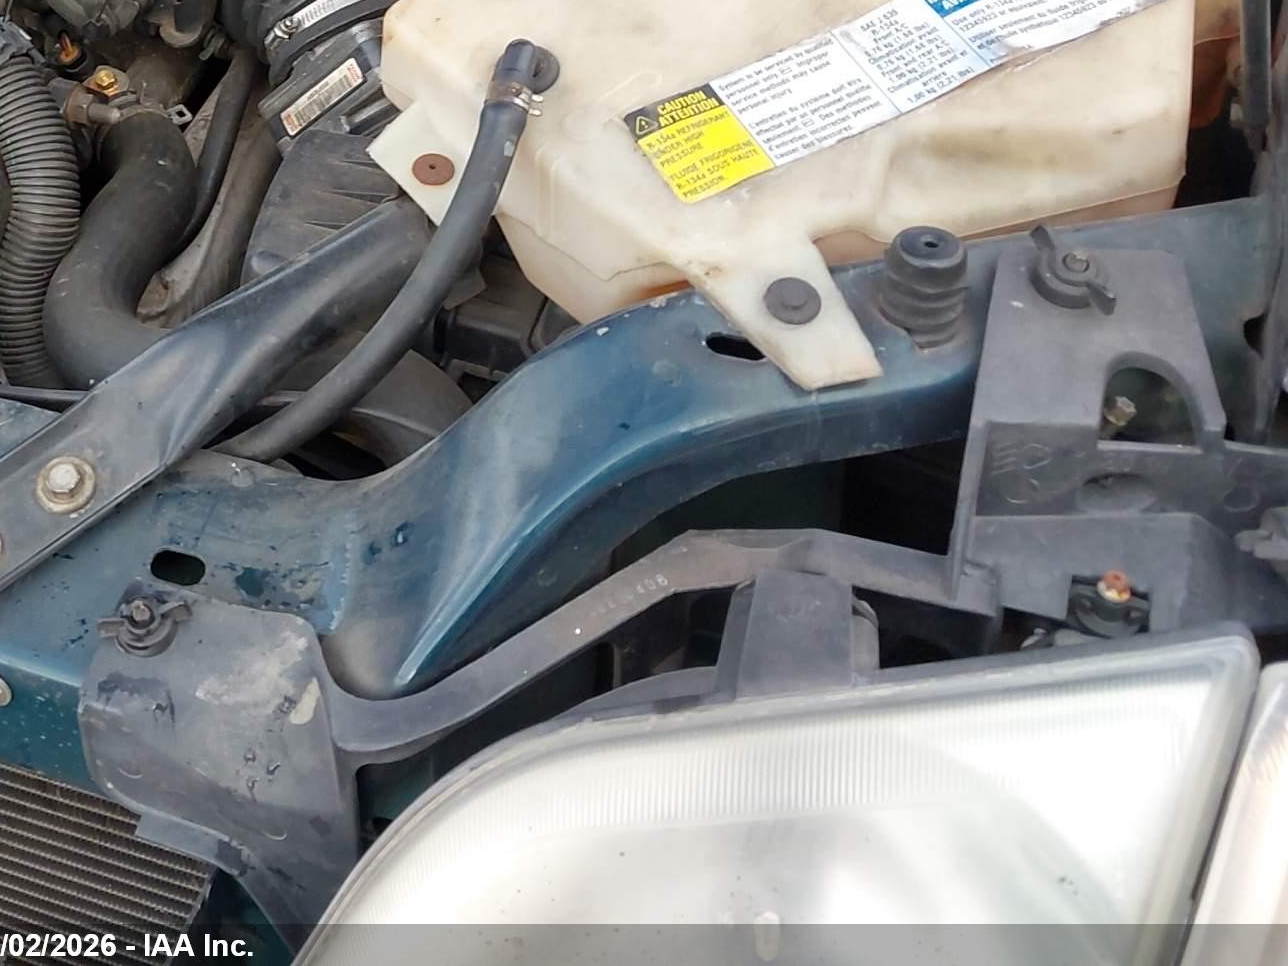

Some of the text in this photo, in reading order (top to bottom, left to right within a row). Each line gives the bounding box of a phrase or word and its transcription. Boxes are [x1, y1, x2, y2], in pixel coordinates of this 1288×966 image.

[860, 20, 875, 31] SAE
[719, 77, 744, 90] System
[657, 91, 705, 115] CAUTION
[659, 98, 717, 127] ATTENTION
[653, 131, 703, 158] UNDER HIGH
[660, 142, 702, 167] PRESSURE
[707, 159, 730, 174] SOUS
[731, 148, 757, 161] HAUTE
